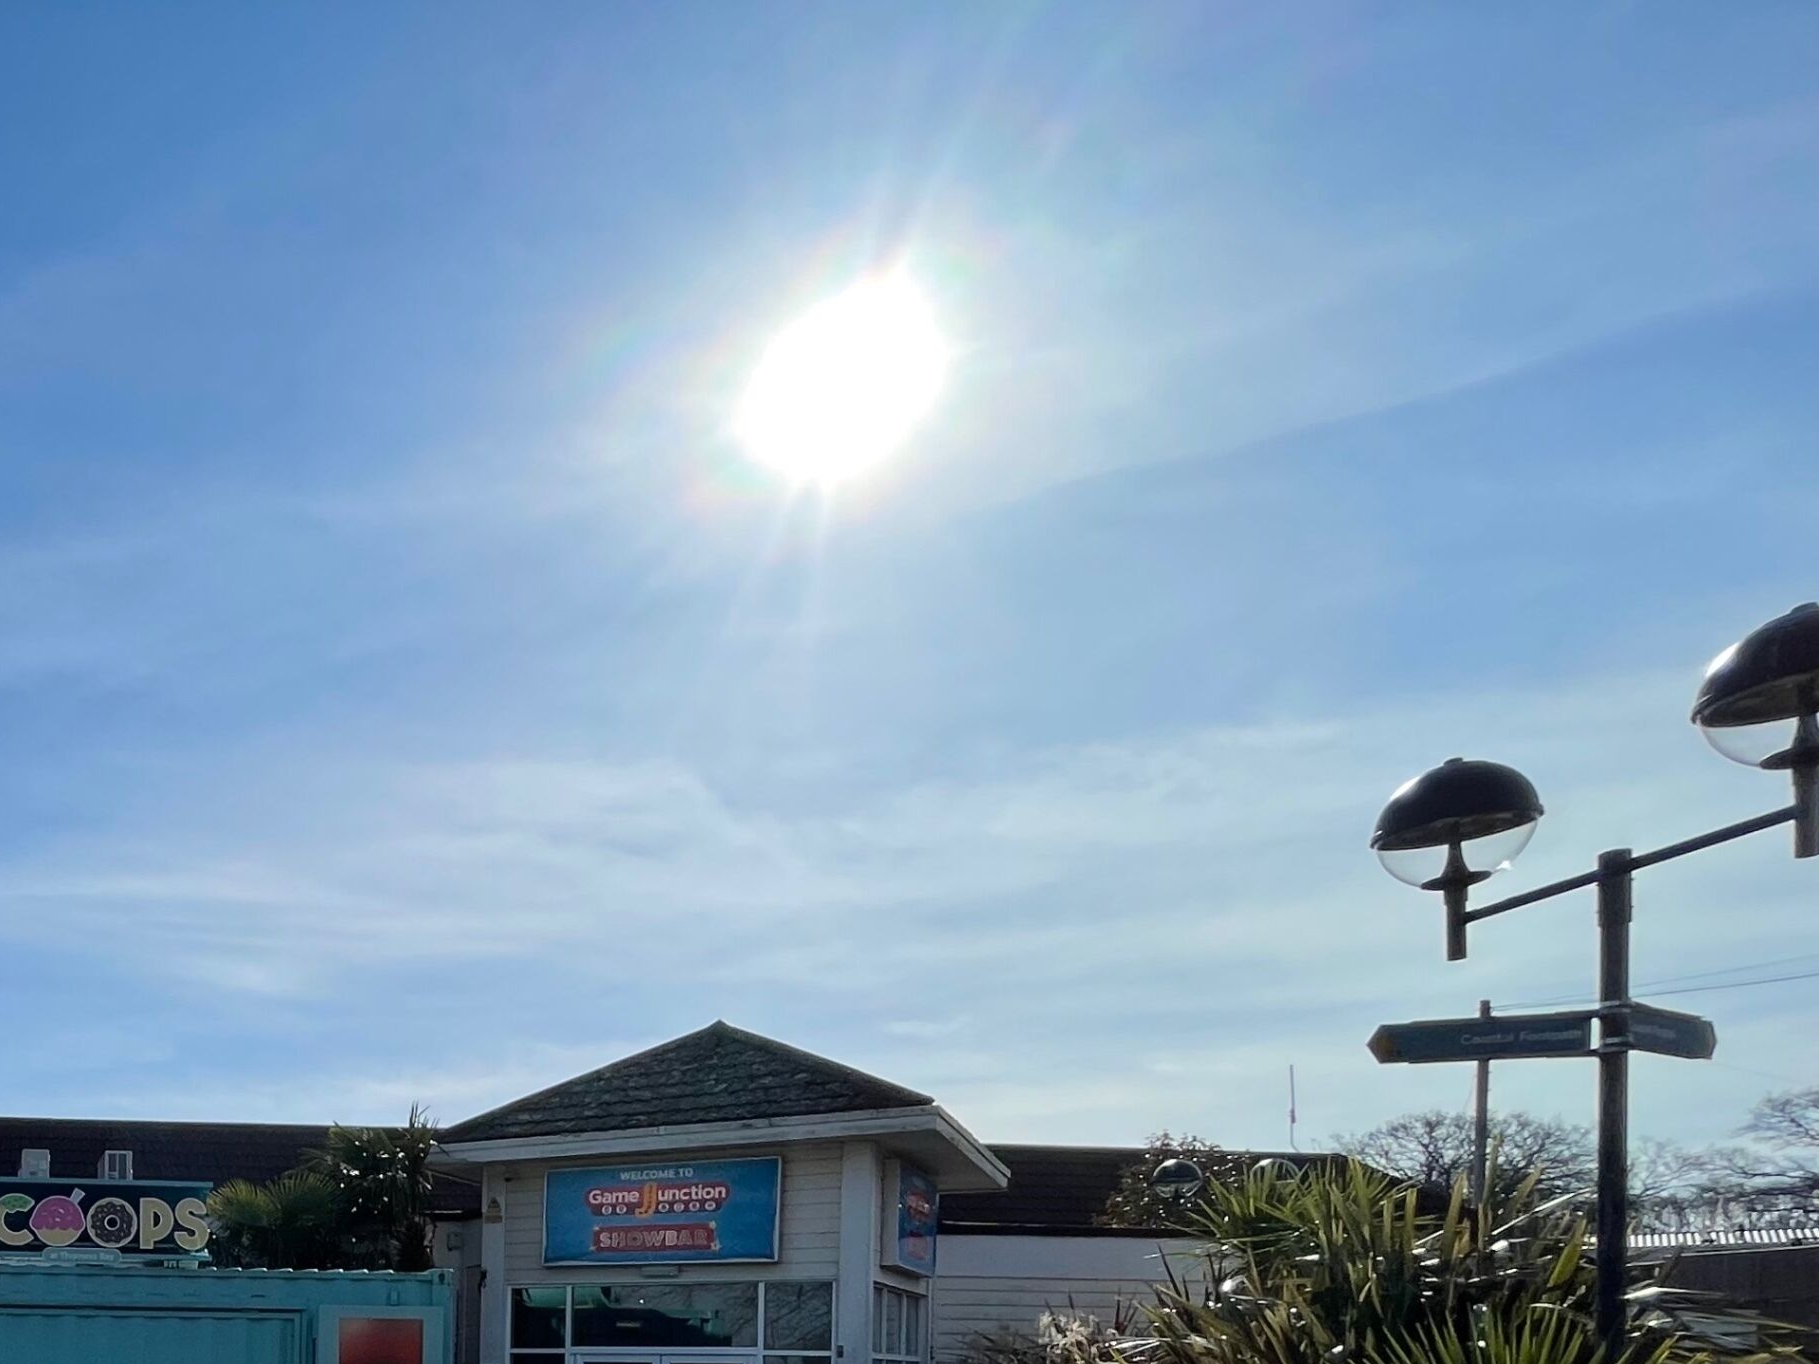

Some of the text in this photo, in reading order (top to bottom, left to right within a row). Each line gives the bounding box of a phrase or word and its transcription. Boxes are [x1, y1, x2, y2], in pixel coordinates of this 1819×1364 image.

[620, 1167, 694, 1180] WELCOME TO
[589, 1182, 726, 1217] Game Junction
[599, 1229, 709, 1248] SHOWBAR
